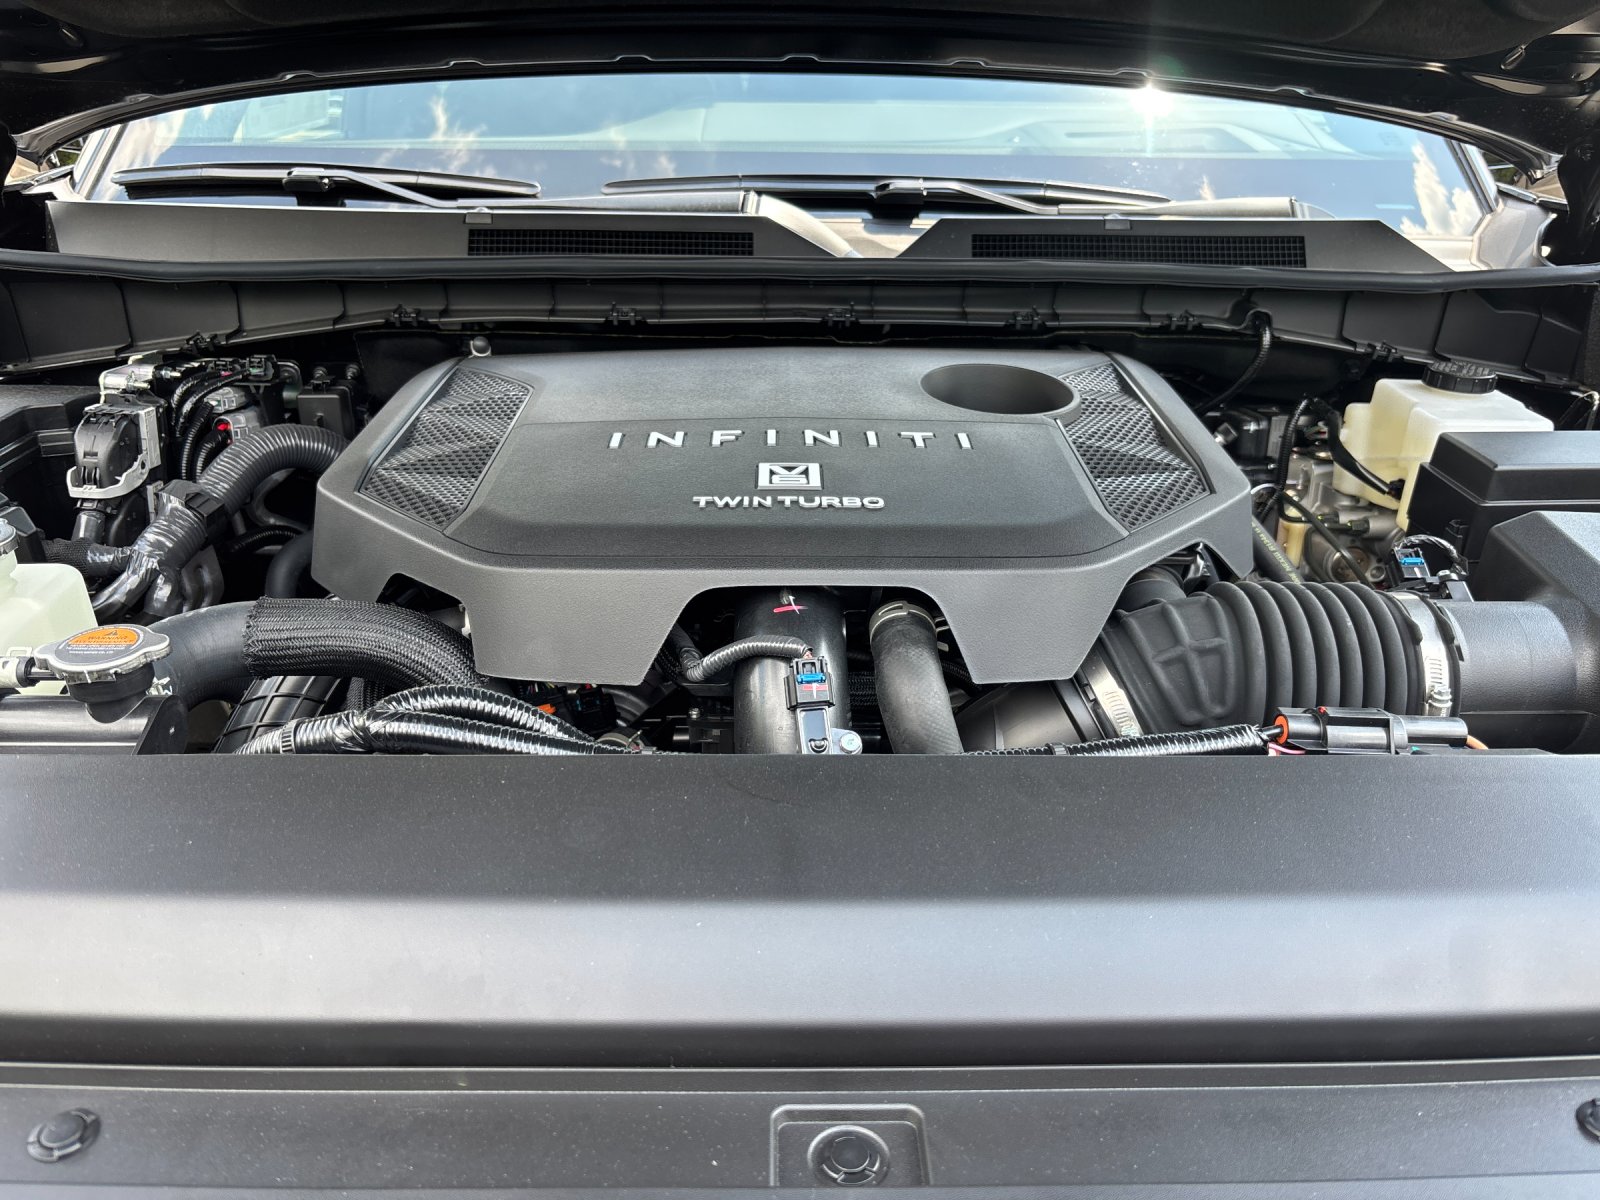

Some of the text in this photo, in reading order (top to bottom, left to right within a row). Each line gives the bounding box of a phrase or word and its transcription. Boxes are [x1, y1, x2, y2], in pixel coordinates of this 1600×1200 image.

[609, 429, 974, 449] INFINITI
[693, 496, 886, 509] TWIN TURBO
